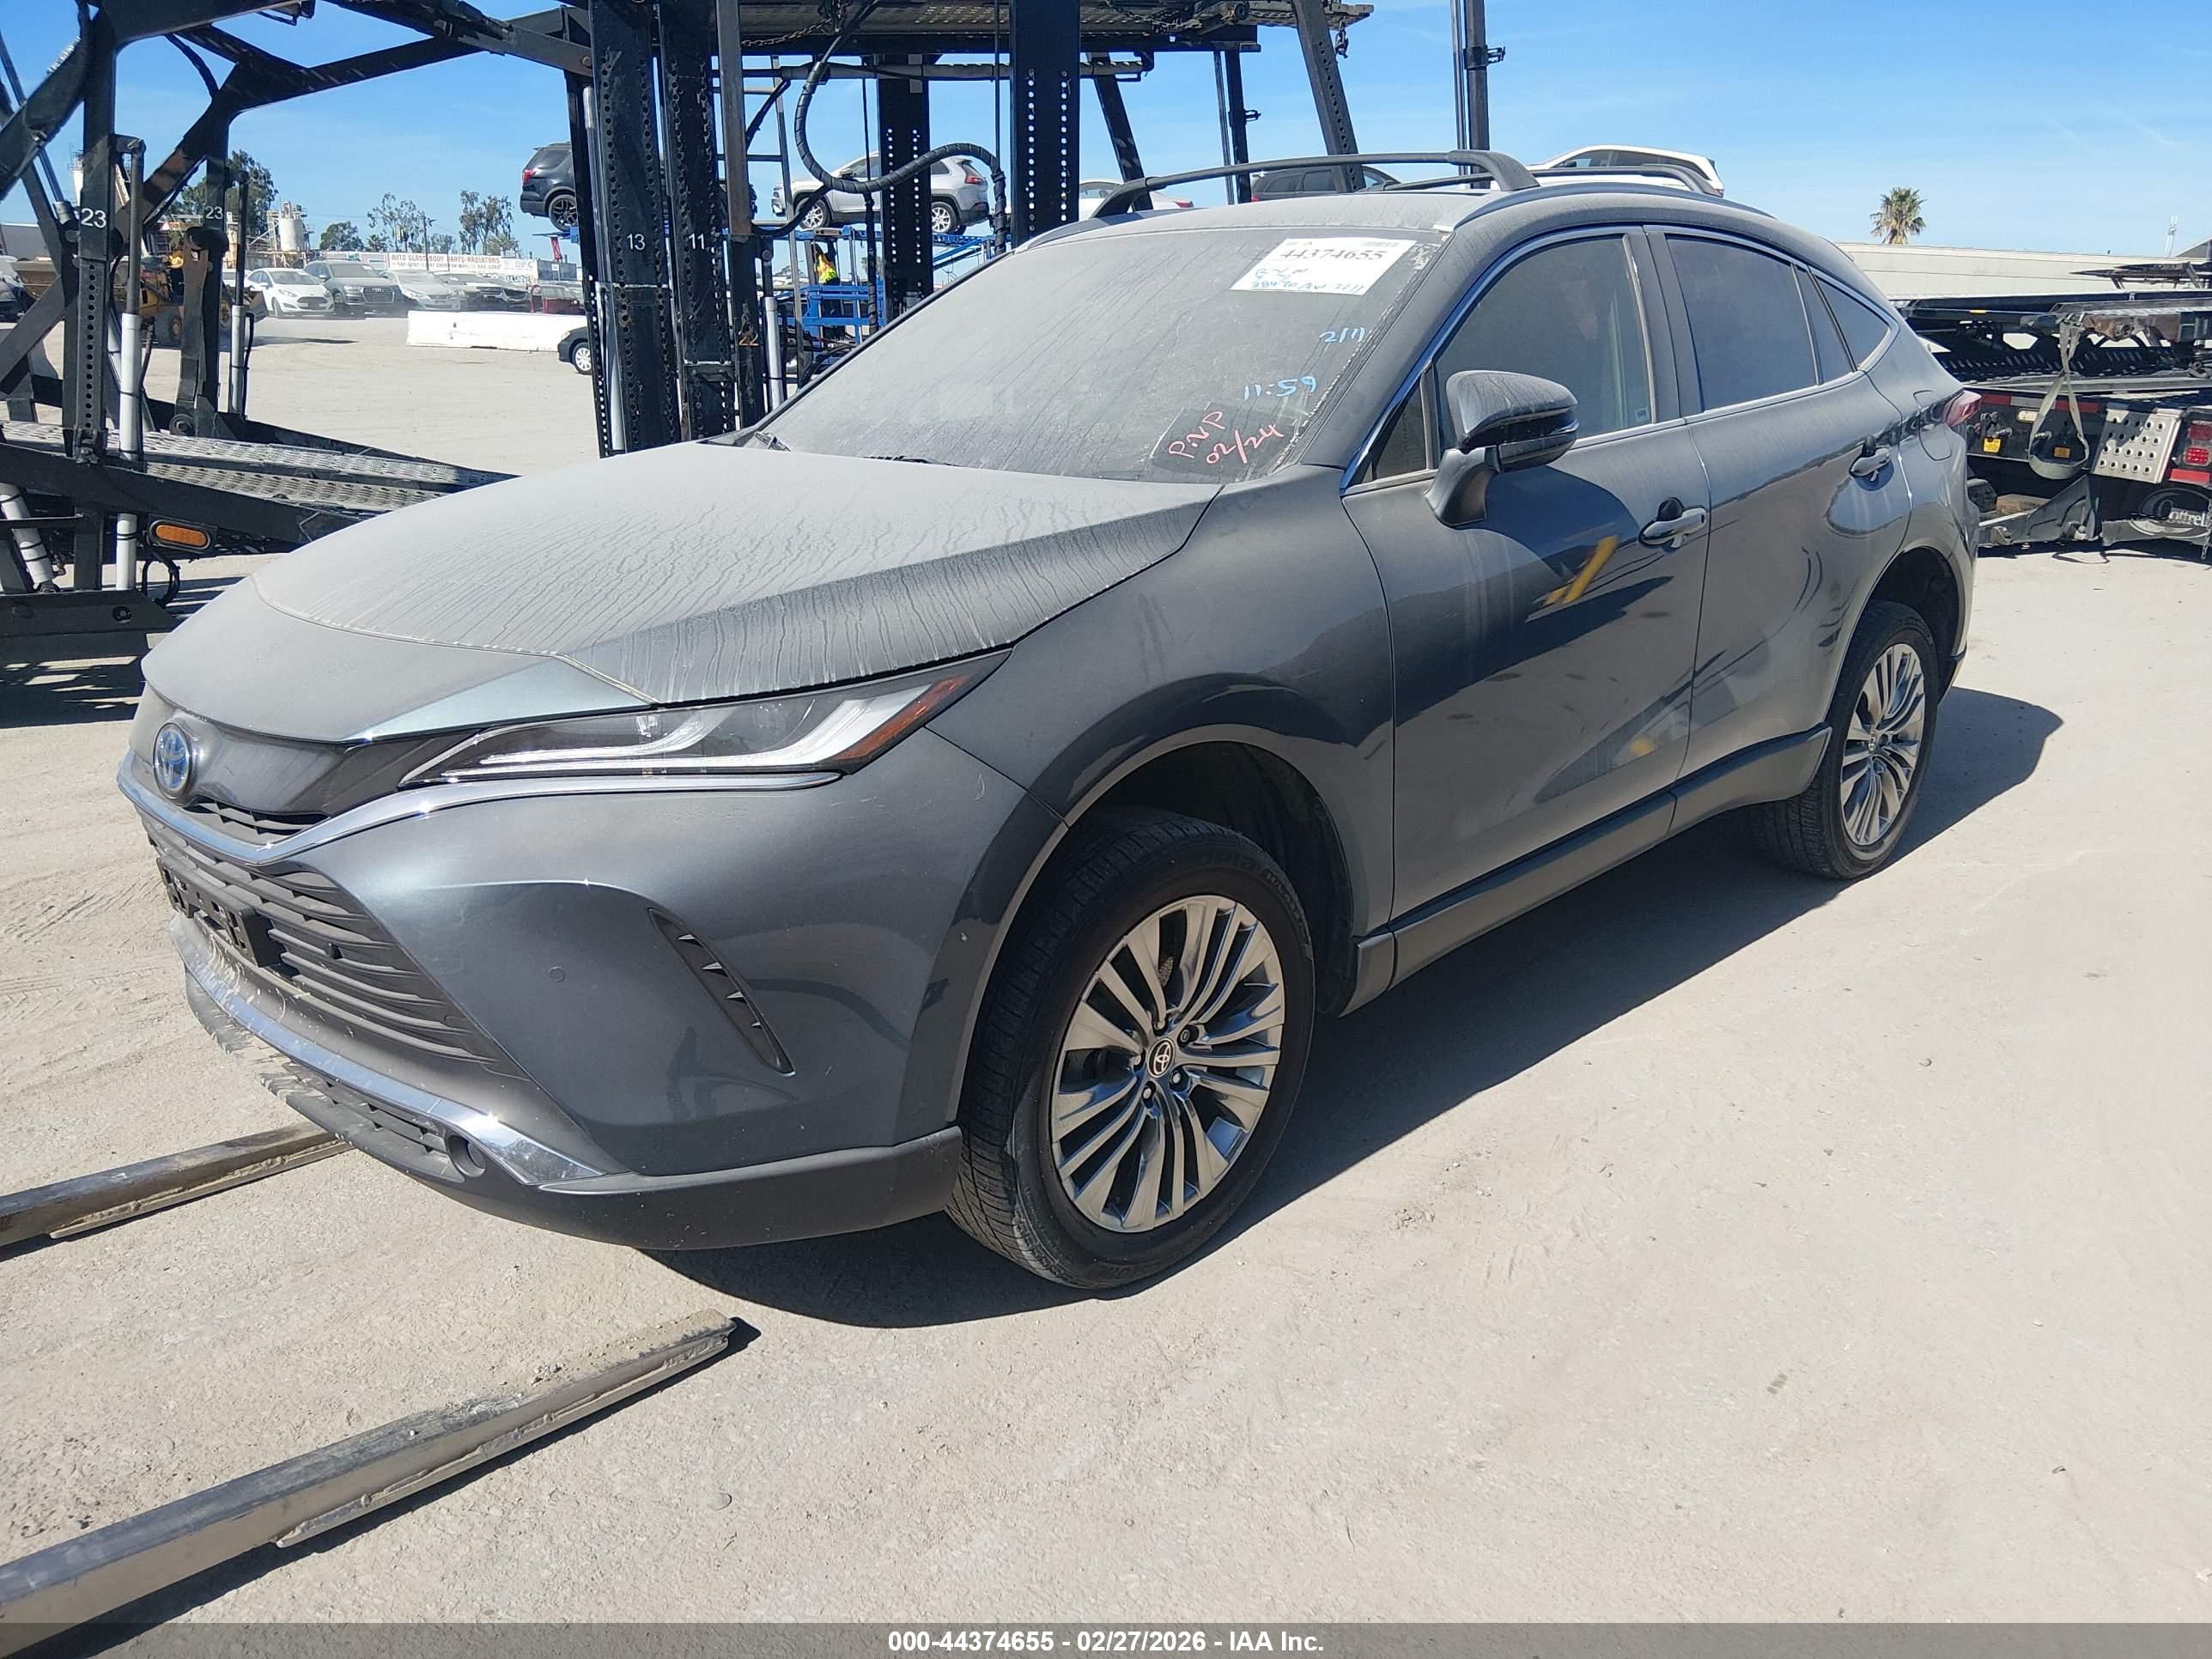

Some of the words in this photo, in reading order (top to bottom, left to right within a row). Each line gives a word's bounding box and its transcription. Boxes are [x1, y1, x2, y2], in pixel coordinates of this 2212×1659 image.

[81, 208, 106, 228] 23
[205, 206, 223, 219] 23
[627, 233, 646, 251] 13
[689, 233, 705, 250] 11
[1280, 249, 1388, 260] 44374655
[1244, 375, 1316, 400] 11:59
[1206, 423, 1285, 465] 02/24
